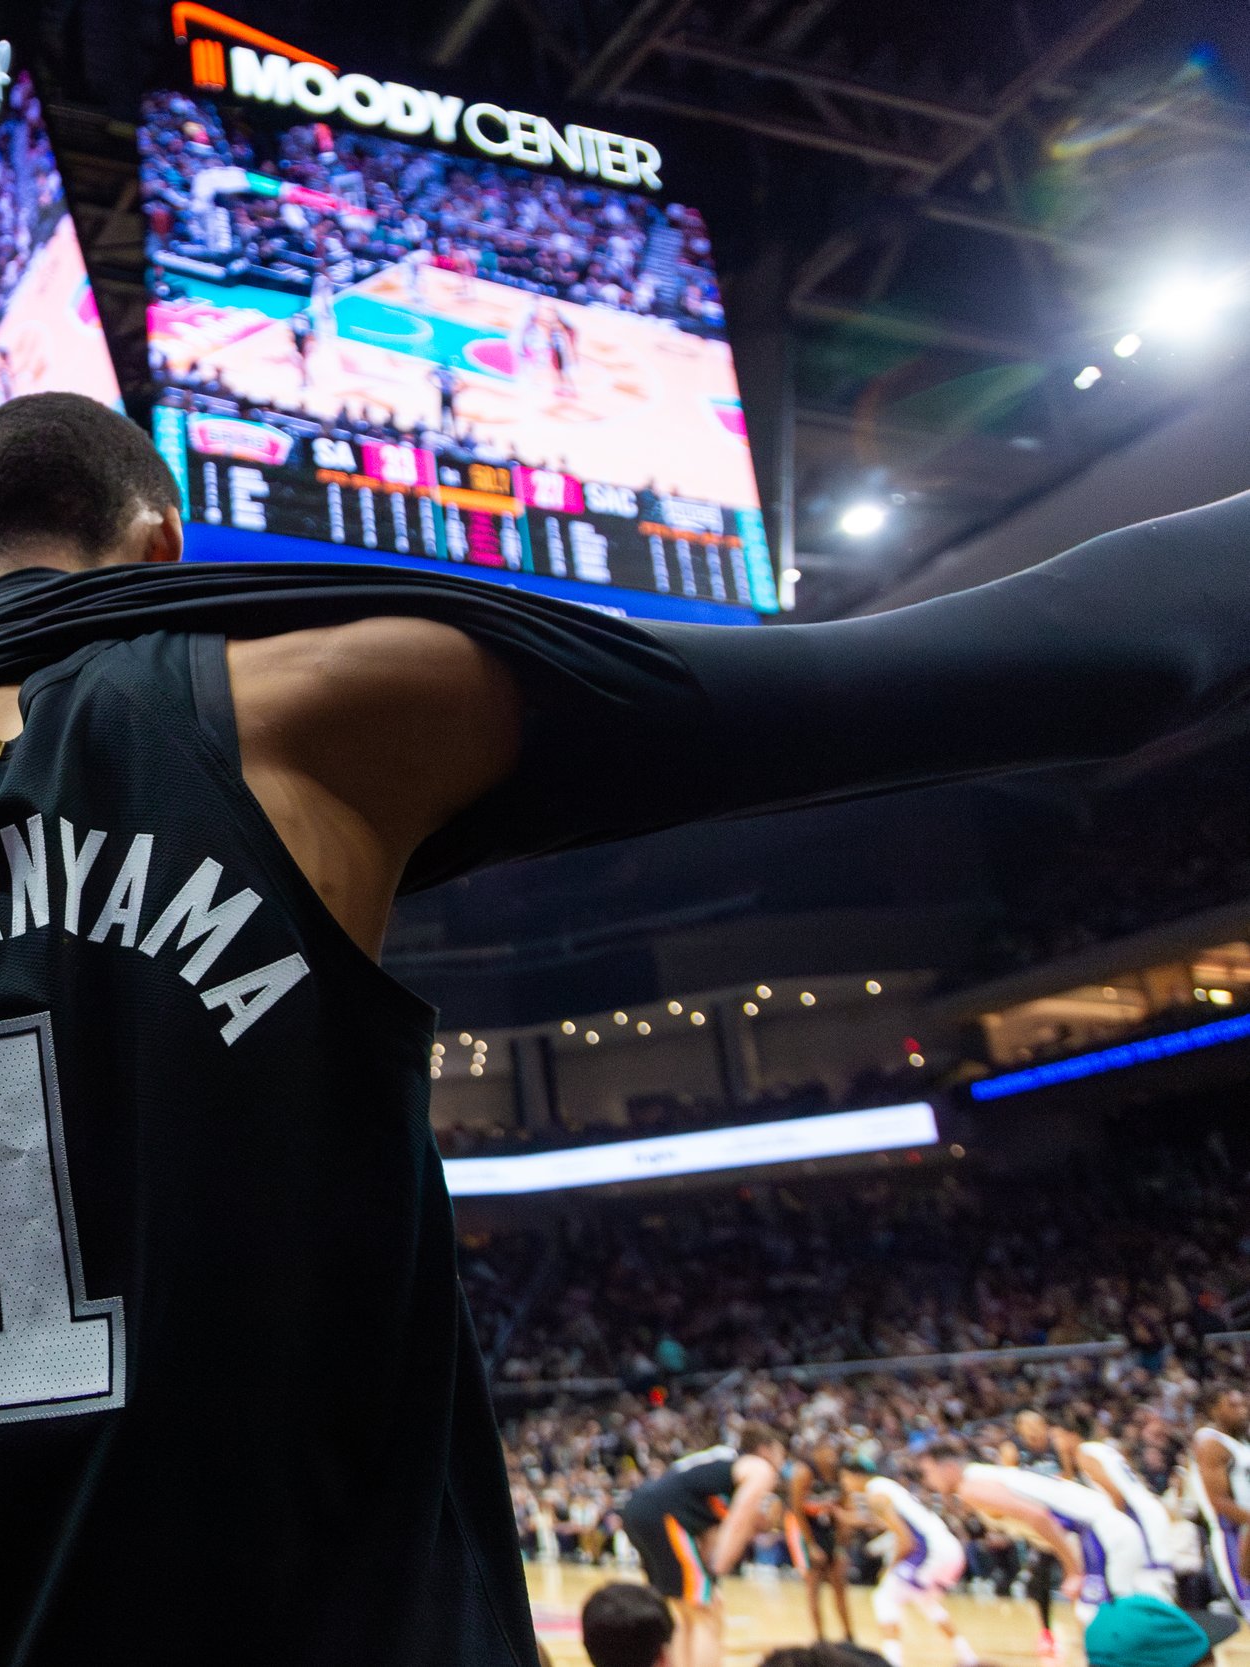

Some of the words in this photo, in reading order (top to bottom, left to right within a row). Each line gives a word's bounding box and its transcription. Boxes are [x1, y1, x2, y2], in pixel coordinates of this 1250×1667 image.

[230, 46, 463, 143] MOODY
[463, 102, 662, 191] CENTER
[584, 482, 639, 519] SAC
